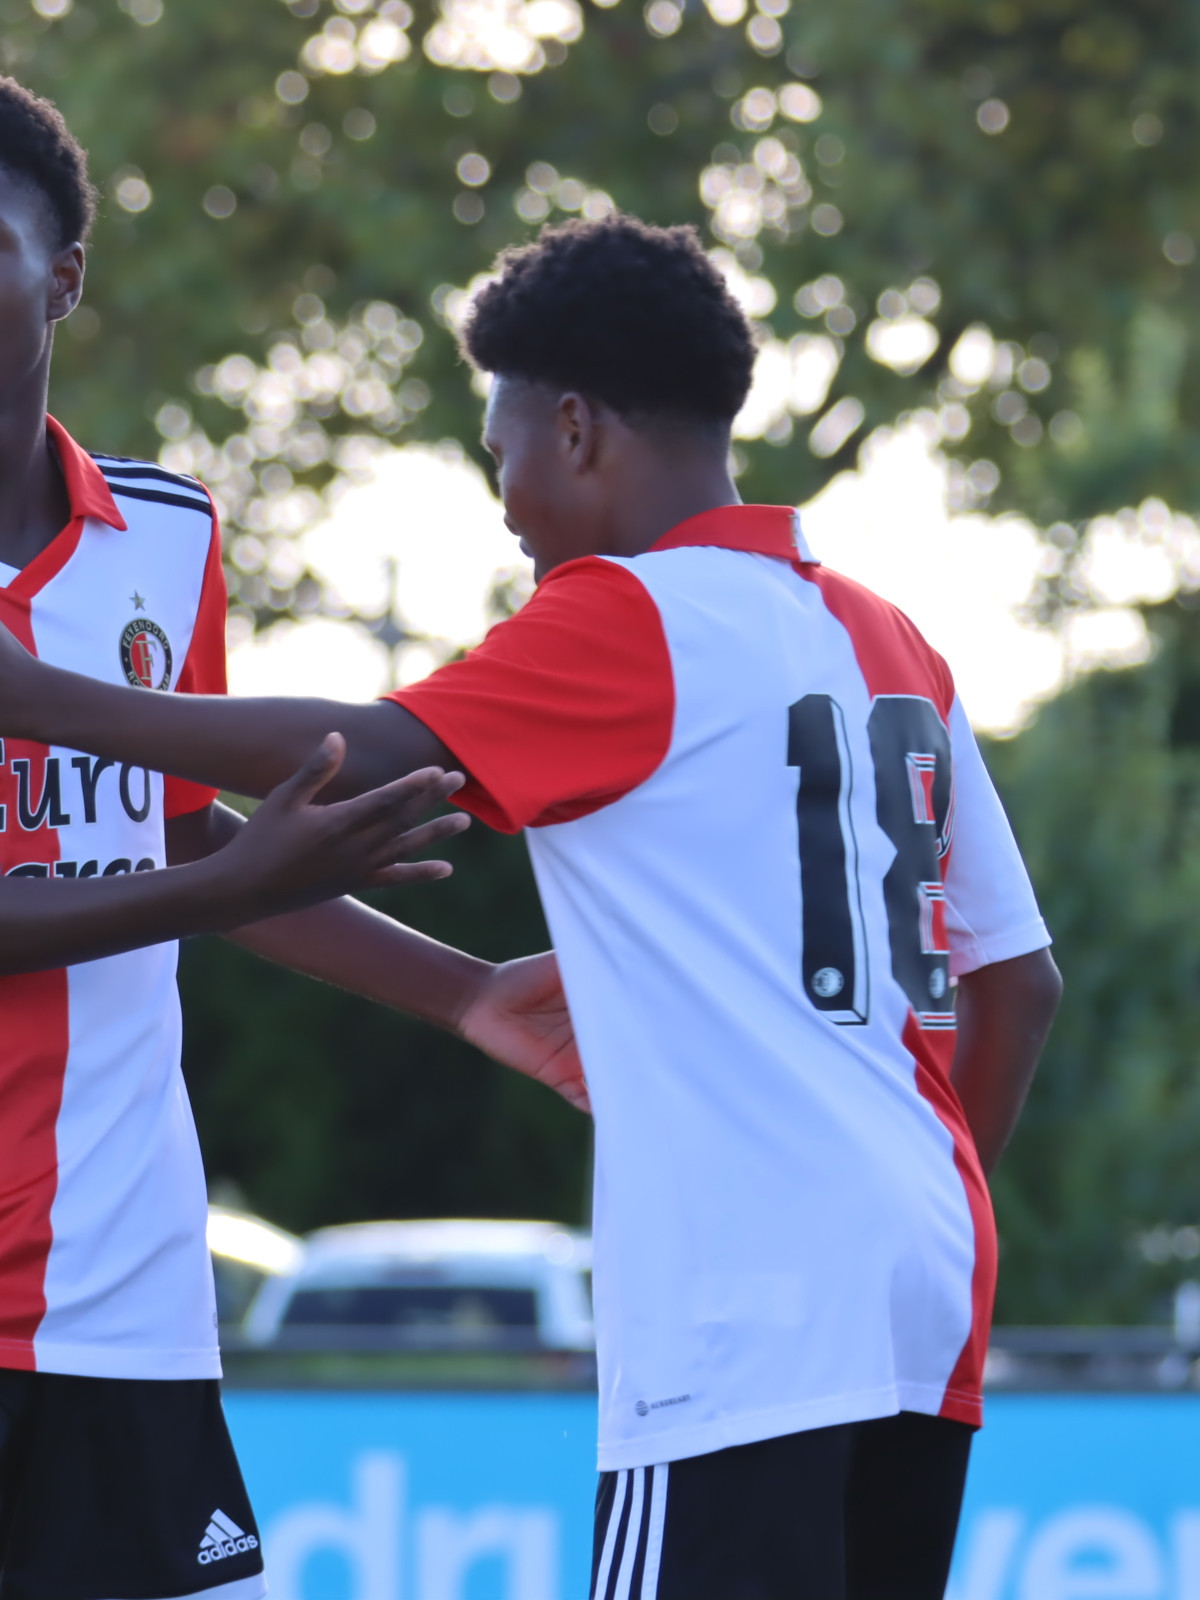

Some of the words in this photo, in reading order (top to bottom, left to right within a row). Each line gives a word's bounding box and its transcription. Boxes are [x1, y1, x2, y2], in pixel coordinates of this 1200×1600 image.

[122, 621, 169, 650] FEYENOORD
[786, 693, 956, 1031] 18
[197, 1534, 259, 1565] adidas
